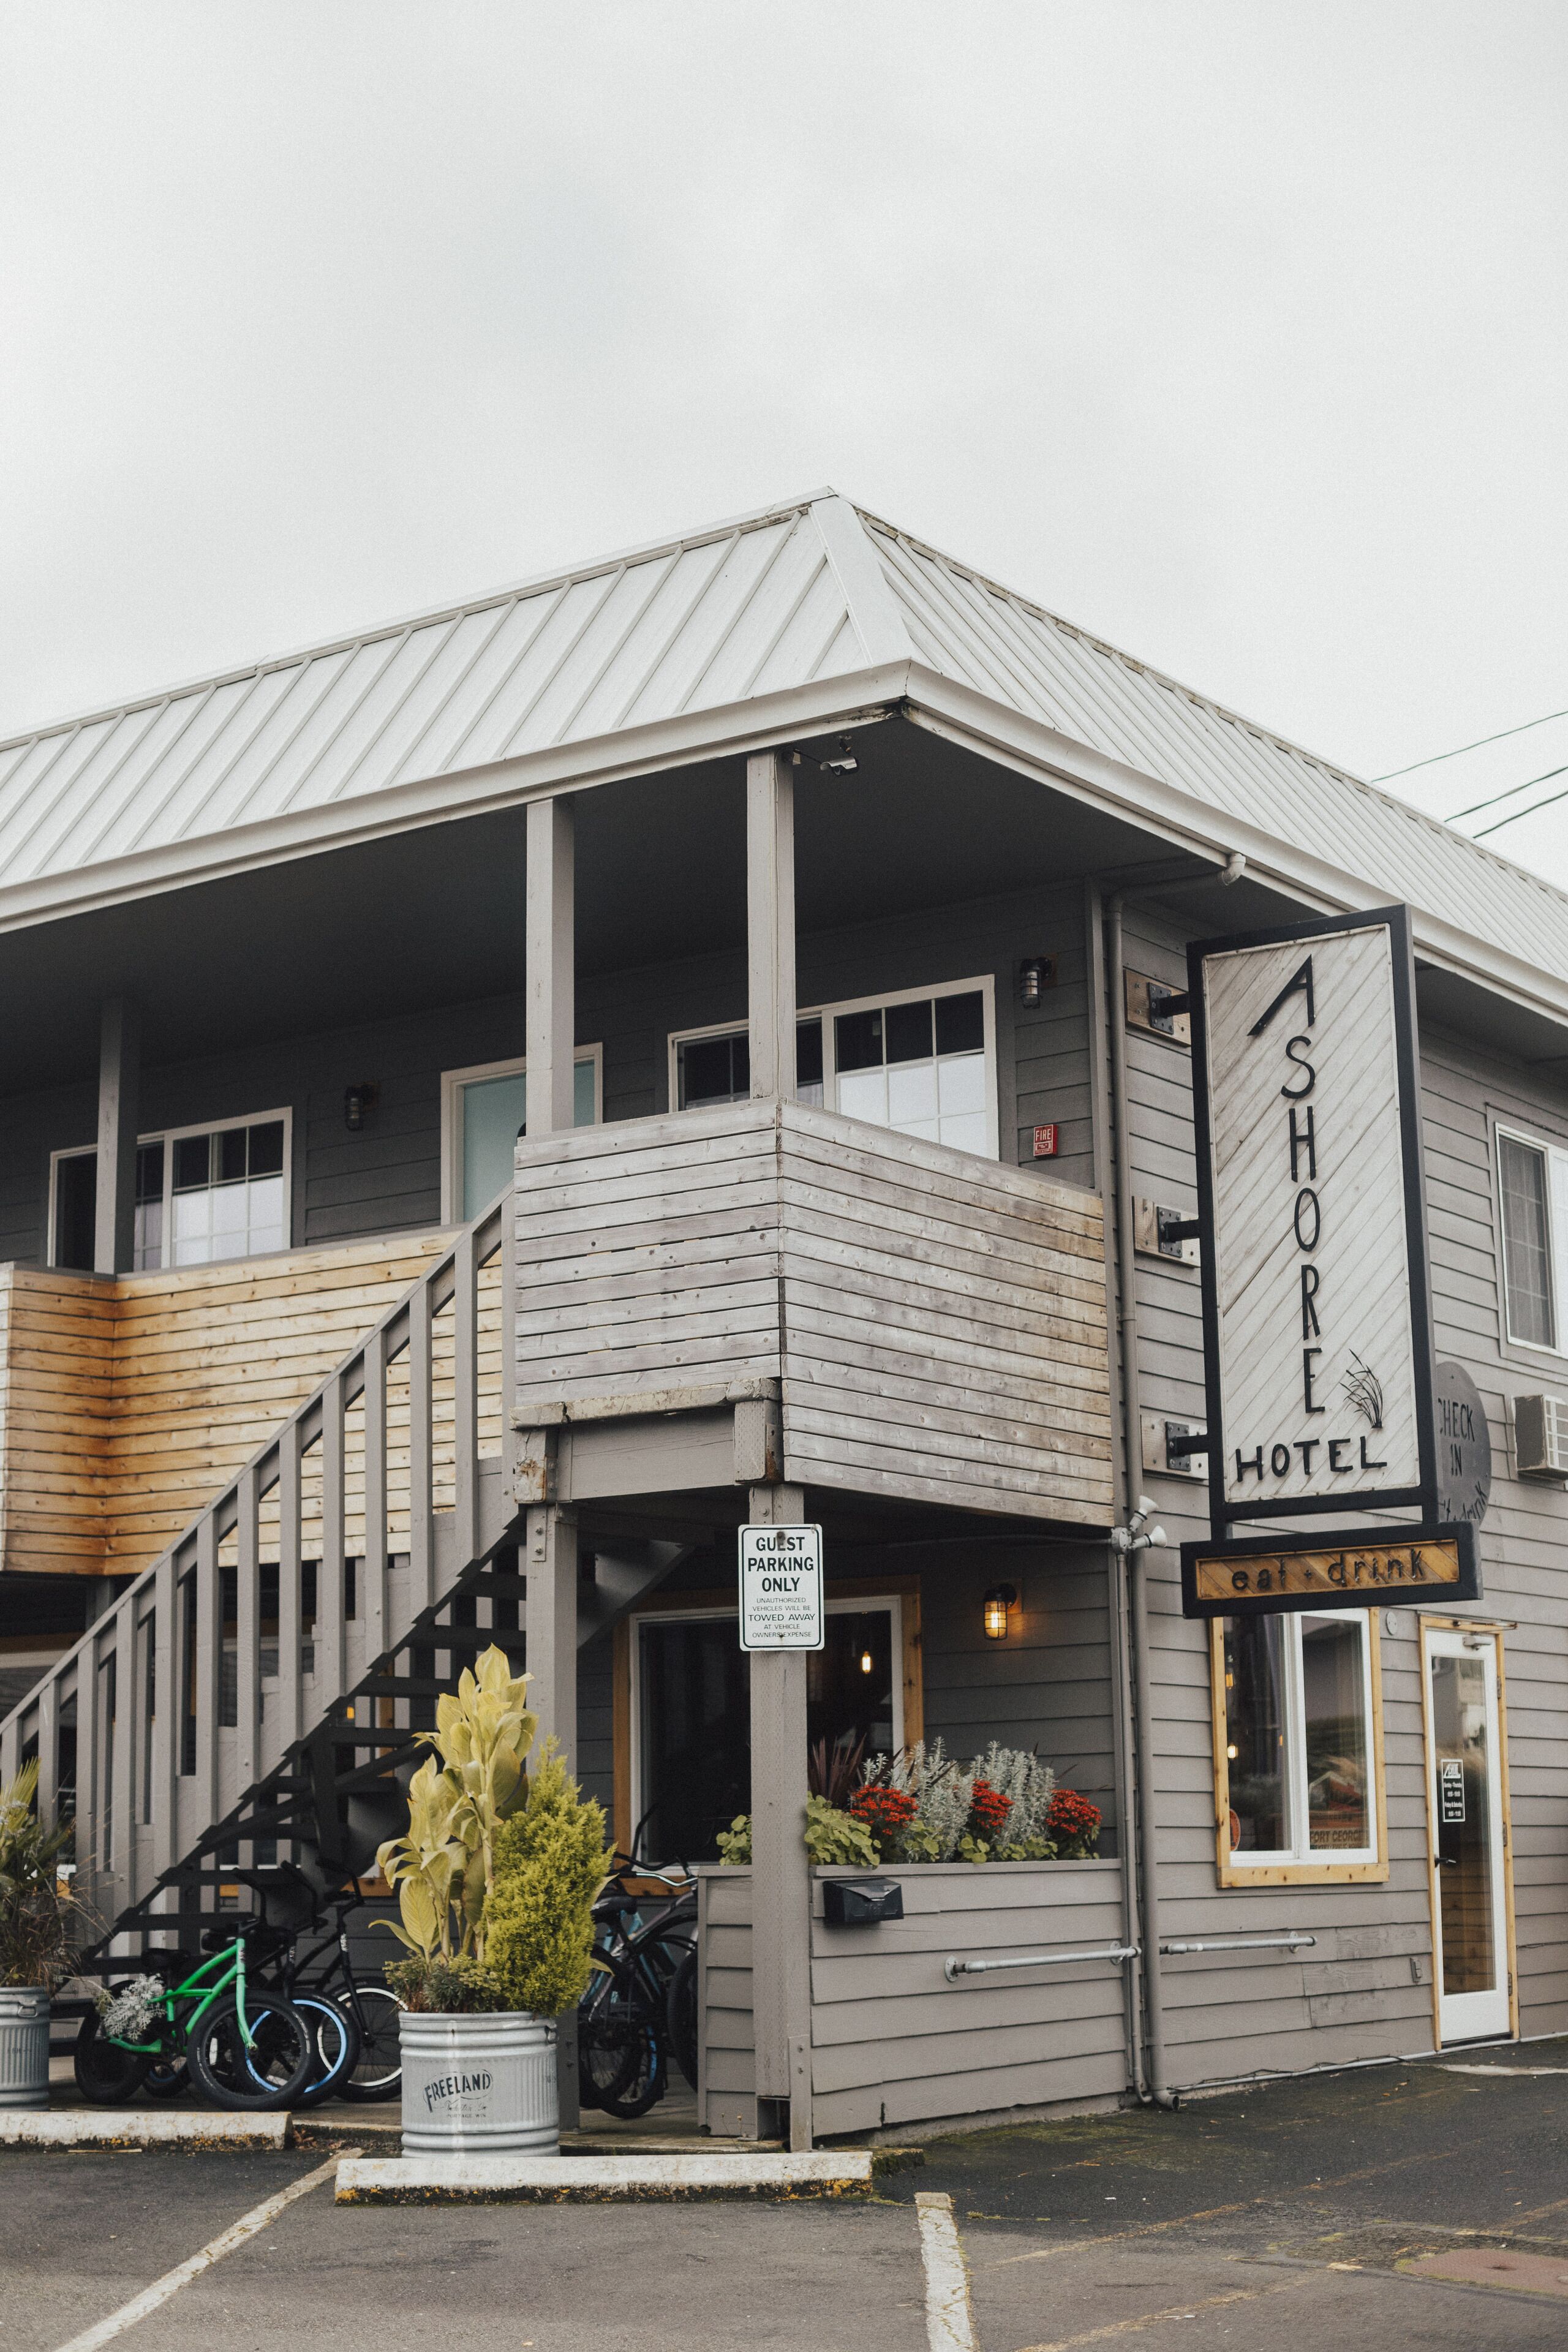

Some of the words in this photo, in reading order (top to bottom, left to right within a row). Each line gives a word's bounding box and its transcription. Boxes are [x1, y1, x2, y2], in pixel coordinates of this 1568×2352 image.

[1036, 1129, 1051, 1141] FIRE
[1246, 954, 1325, 1414] ASHORE
[1235, 1436, 1387, 1482] HOTEL
[1450, 1443, 1463, 1477] IN
[756, 1536, 805, 1551] GUEST
[748, 1556, 814, 1572] PARKING
[1232, 1558, 1286, 1591] eat
[1327, 1548, 1424, 1588] drink
[762, 1577, 800, 1592] ONLY
[424, 2073, 491, 2113] FREELAND
